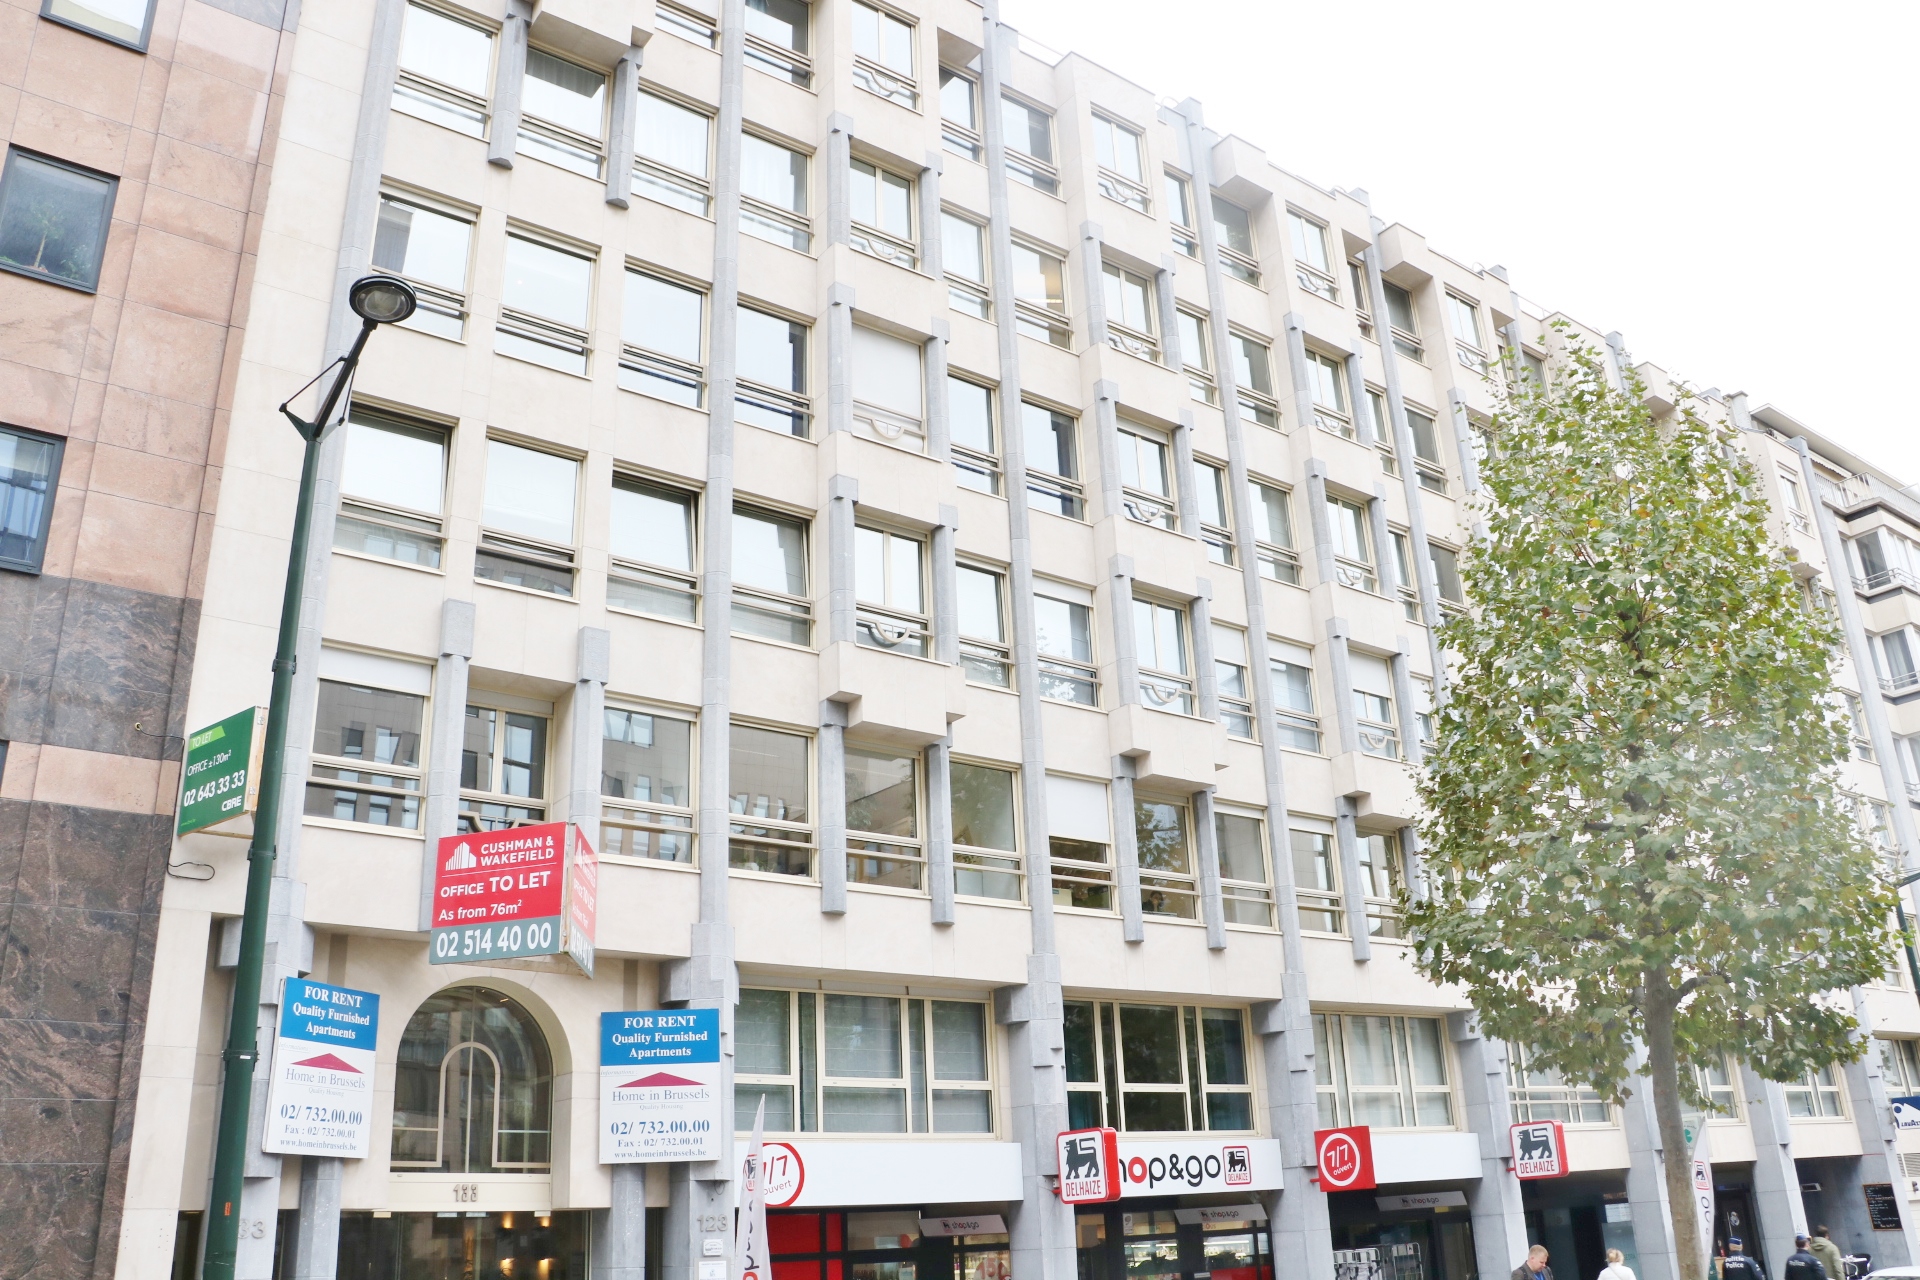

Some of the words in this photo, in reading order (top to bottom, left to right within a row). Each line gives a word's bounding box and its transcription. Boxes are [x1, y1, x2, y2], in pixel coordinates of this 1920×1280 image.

[192, 737, 201, 748] TO
[201, 731, 212, 745] LET
[187, 759, 208, 776] OFFICE
[183, 788, 197, 807] 02
[197, 781, 216, 801] 643
[217, 775, 230, 794] 33
[231, 769, 246, 789] 33
[221, 795, 242, 812] CBRE
[481, 836, 543, 854] CUSHMAN
[545, 836, 554, 846] &
[480, 848, 554, 866] WAKEFIELD
[440, 882, 484, 898] OFFICE
[489, 875, 513, 893] TO
[518, 871, 551, 890] LET
[438, 909, 454, 921] As
[457, 906, 486, 919] from
[436, 931, 459, 958] 02
[463, 927, 492, 956] 514
[497, 925, 522, 952] 40
[527, 922, 552, 950] 00
[304, 985, 329, 1002] FOR
[331, 991, 363, 1008] RENT
[292, 1002, 326, 1020] Quality
[328, 1008, 370, 1026] Furnished
[623, 1017, 654, 1029] FOR
[657, 1015, 697, 1027] RENT
[305, 1021, 356, 1040] Apartments
[612, 1033, 651, 1046] Quality
[654, 1031, 708, 1043] Furnished
[629, 1047, 692, 1060] Apartments
[285, 1068, 315, 1083] Home
[318, 1072, 327, 1084] in
[329, 1071, 366, 1089] Brussels
[612, 1090, 646, 1102] Home
[649, 1090, 660, 1101] in
[664, 1088, 710, 1100] Brussels
[280, 1104, 302, 1120] 02/
[305, 1106, 363, 1126] 732.00.00
[284, 1124, 300, 1135] Fax
[307, 1126, 320, 1136] 02/
[322, 1127, 356, 1139] 732.00.01
[610, 1121, 634, 1135] 02/
[638, 1119, 711, 1134] 732.00.00
[280, 1138, 358, 1151] www.homeinbrussels.be
[617, 1139, 635, 1148] Fax
[643, 1138, 658, 1147] 02/
[660, 1137, 704, 1147] 732.00.01
[614, 1148, 707, 1159] www.homeinbrussels.be
[1326, 1143, 1349, 1168] 7/7
[1333, 1162, 1353, 1176] ouvert
[1519, 1160, 1555, 1174] DELHAIZE
[1228, 1172, 1249, 1182] DELHAIZE
[453, 1184, 478, 1203] 133
[764, 1179, 792, 1196] ouvert
[1065, 1179, 1102, 1197] DELHAIZE
[697, 1214, 728, 1233] 123
